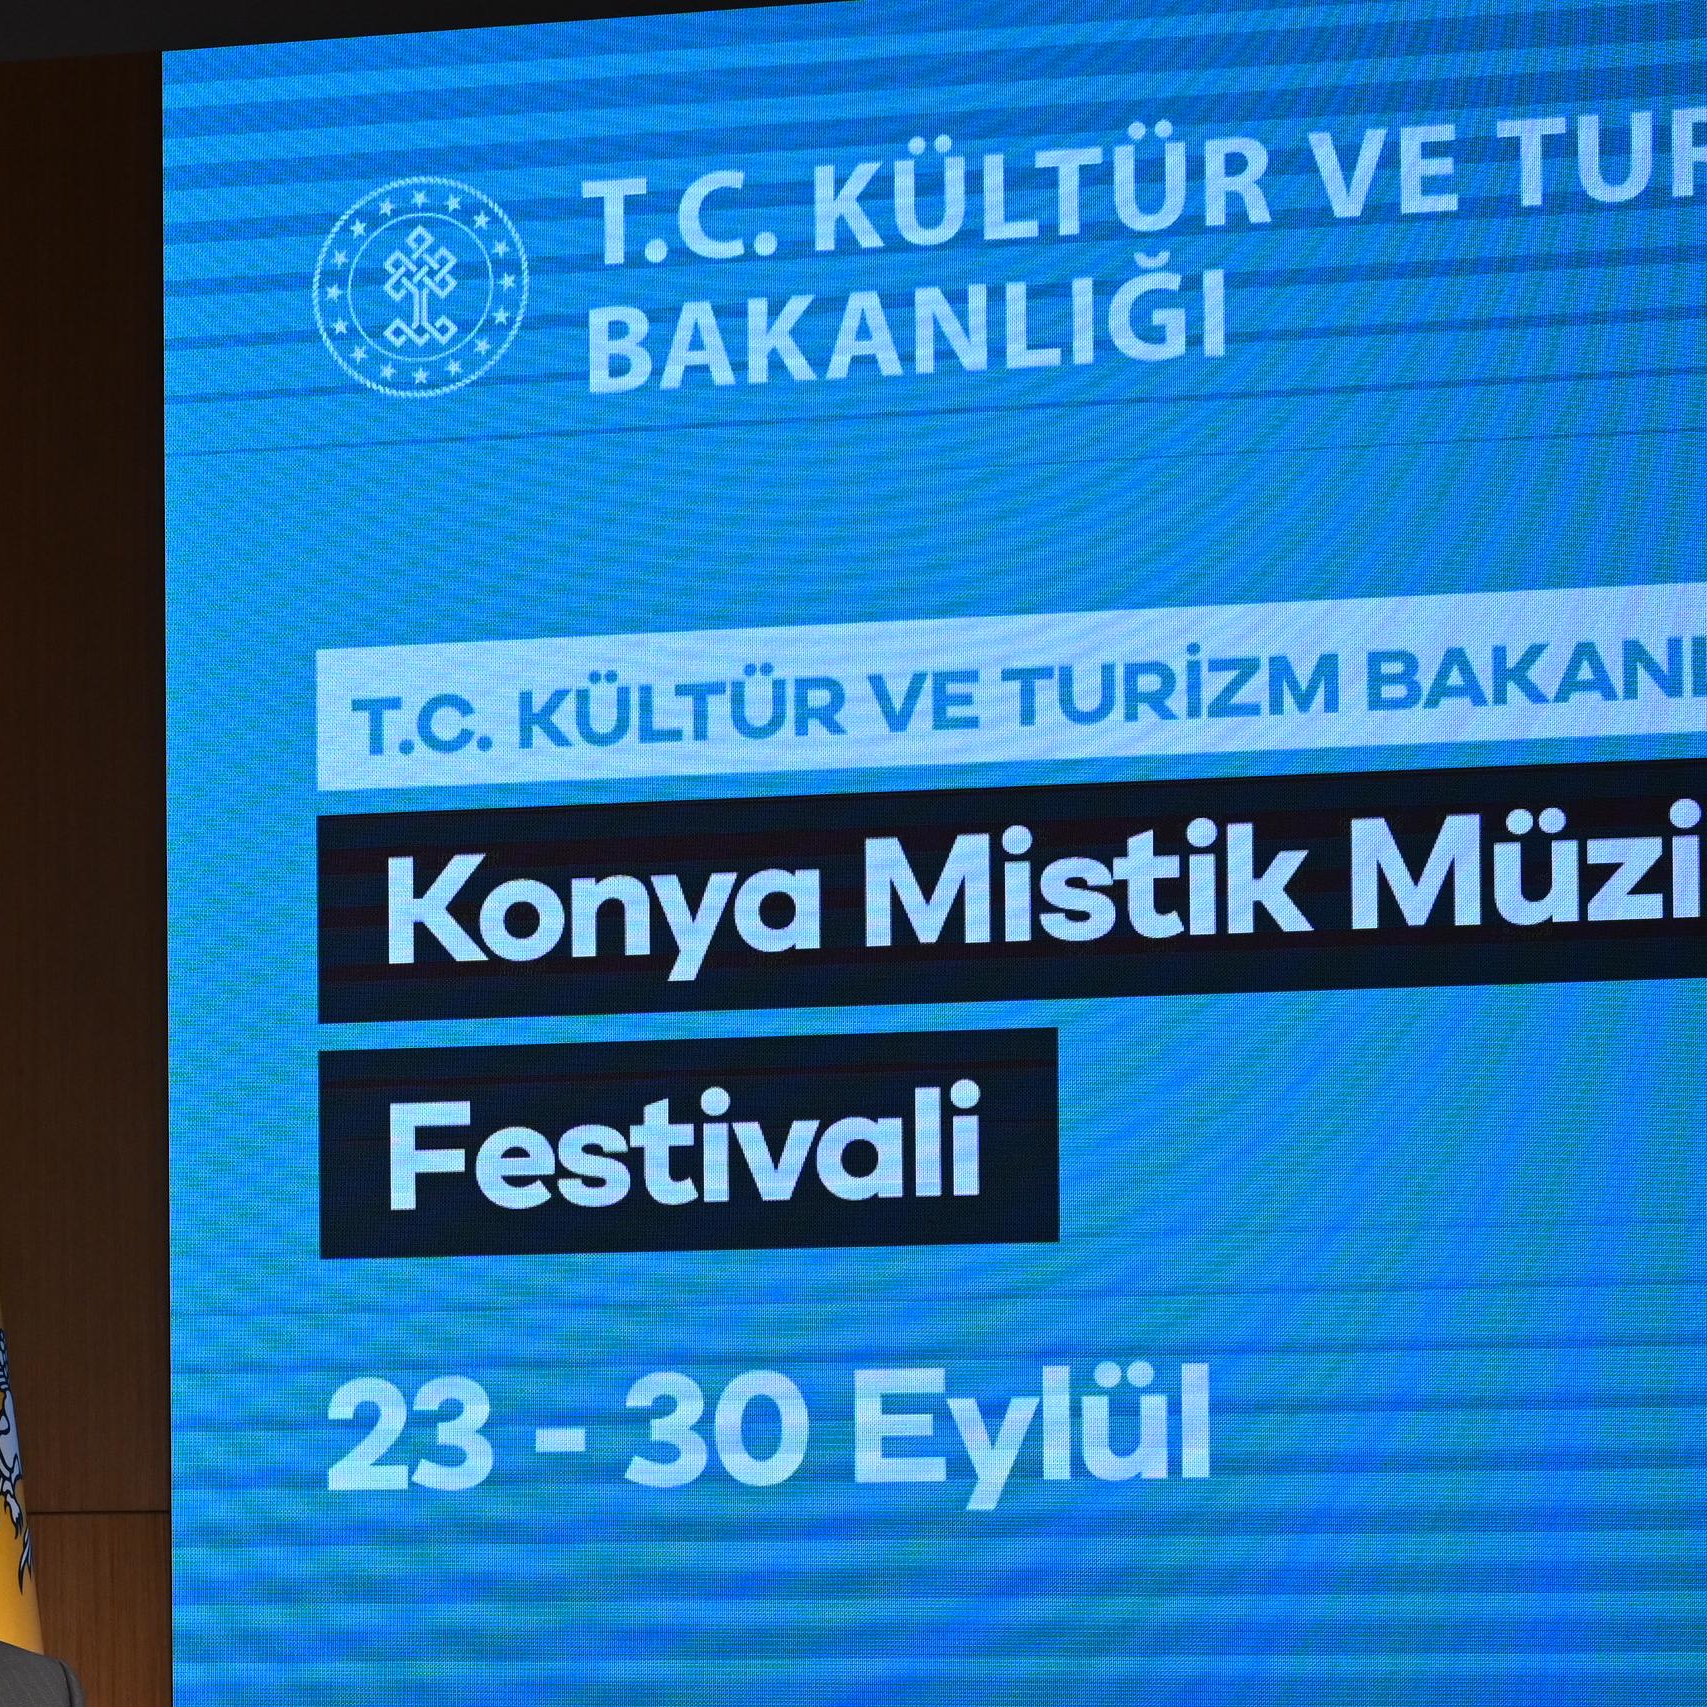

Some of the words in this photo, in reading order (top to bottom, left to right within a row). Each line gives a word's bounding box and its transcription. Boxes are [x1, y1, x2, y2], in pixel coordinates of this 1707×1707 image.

[581, 170, 778, 265] T.C.
[814, 120, 1272, 252] KÜLTÜR
[1308, 128, 1459, 218] VE
[588, 251, 1226, 394] BAKANLIĞI
[350, 692, 494, 757] T.C.
[517, 661, 848, 751] KÜLTÜR
[866, 668, 982, 735] VE
[1000, 641, 1341, 728] TURİZM
[386, 852, 822, 982] Konya
[863, 816, 1313, 948] Mistik
[1349, 798, 1702, 931] Müzi
[388, 1078, 981, 1212] Festivali
[327, 1375, 495, 1492] 23
[535, 1428, 587, 1453] -
[625, 1370, 810, 1489] 30
[853, 1361, 1211, 1511] Eylül
